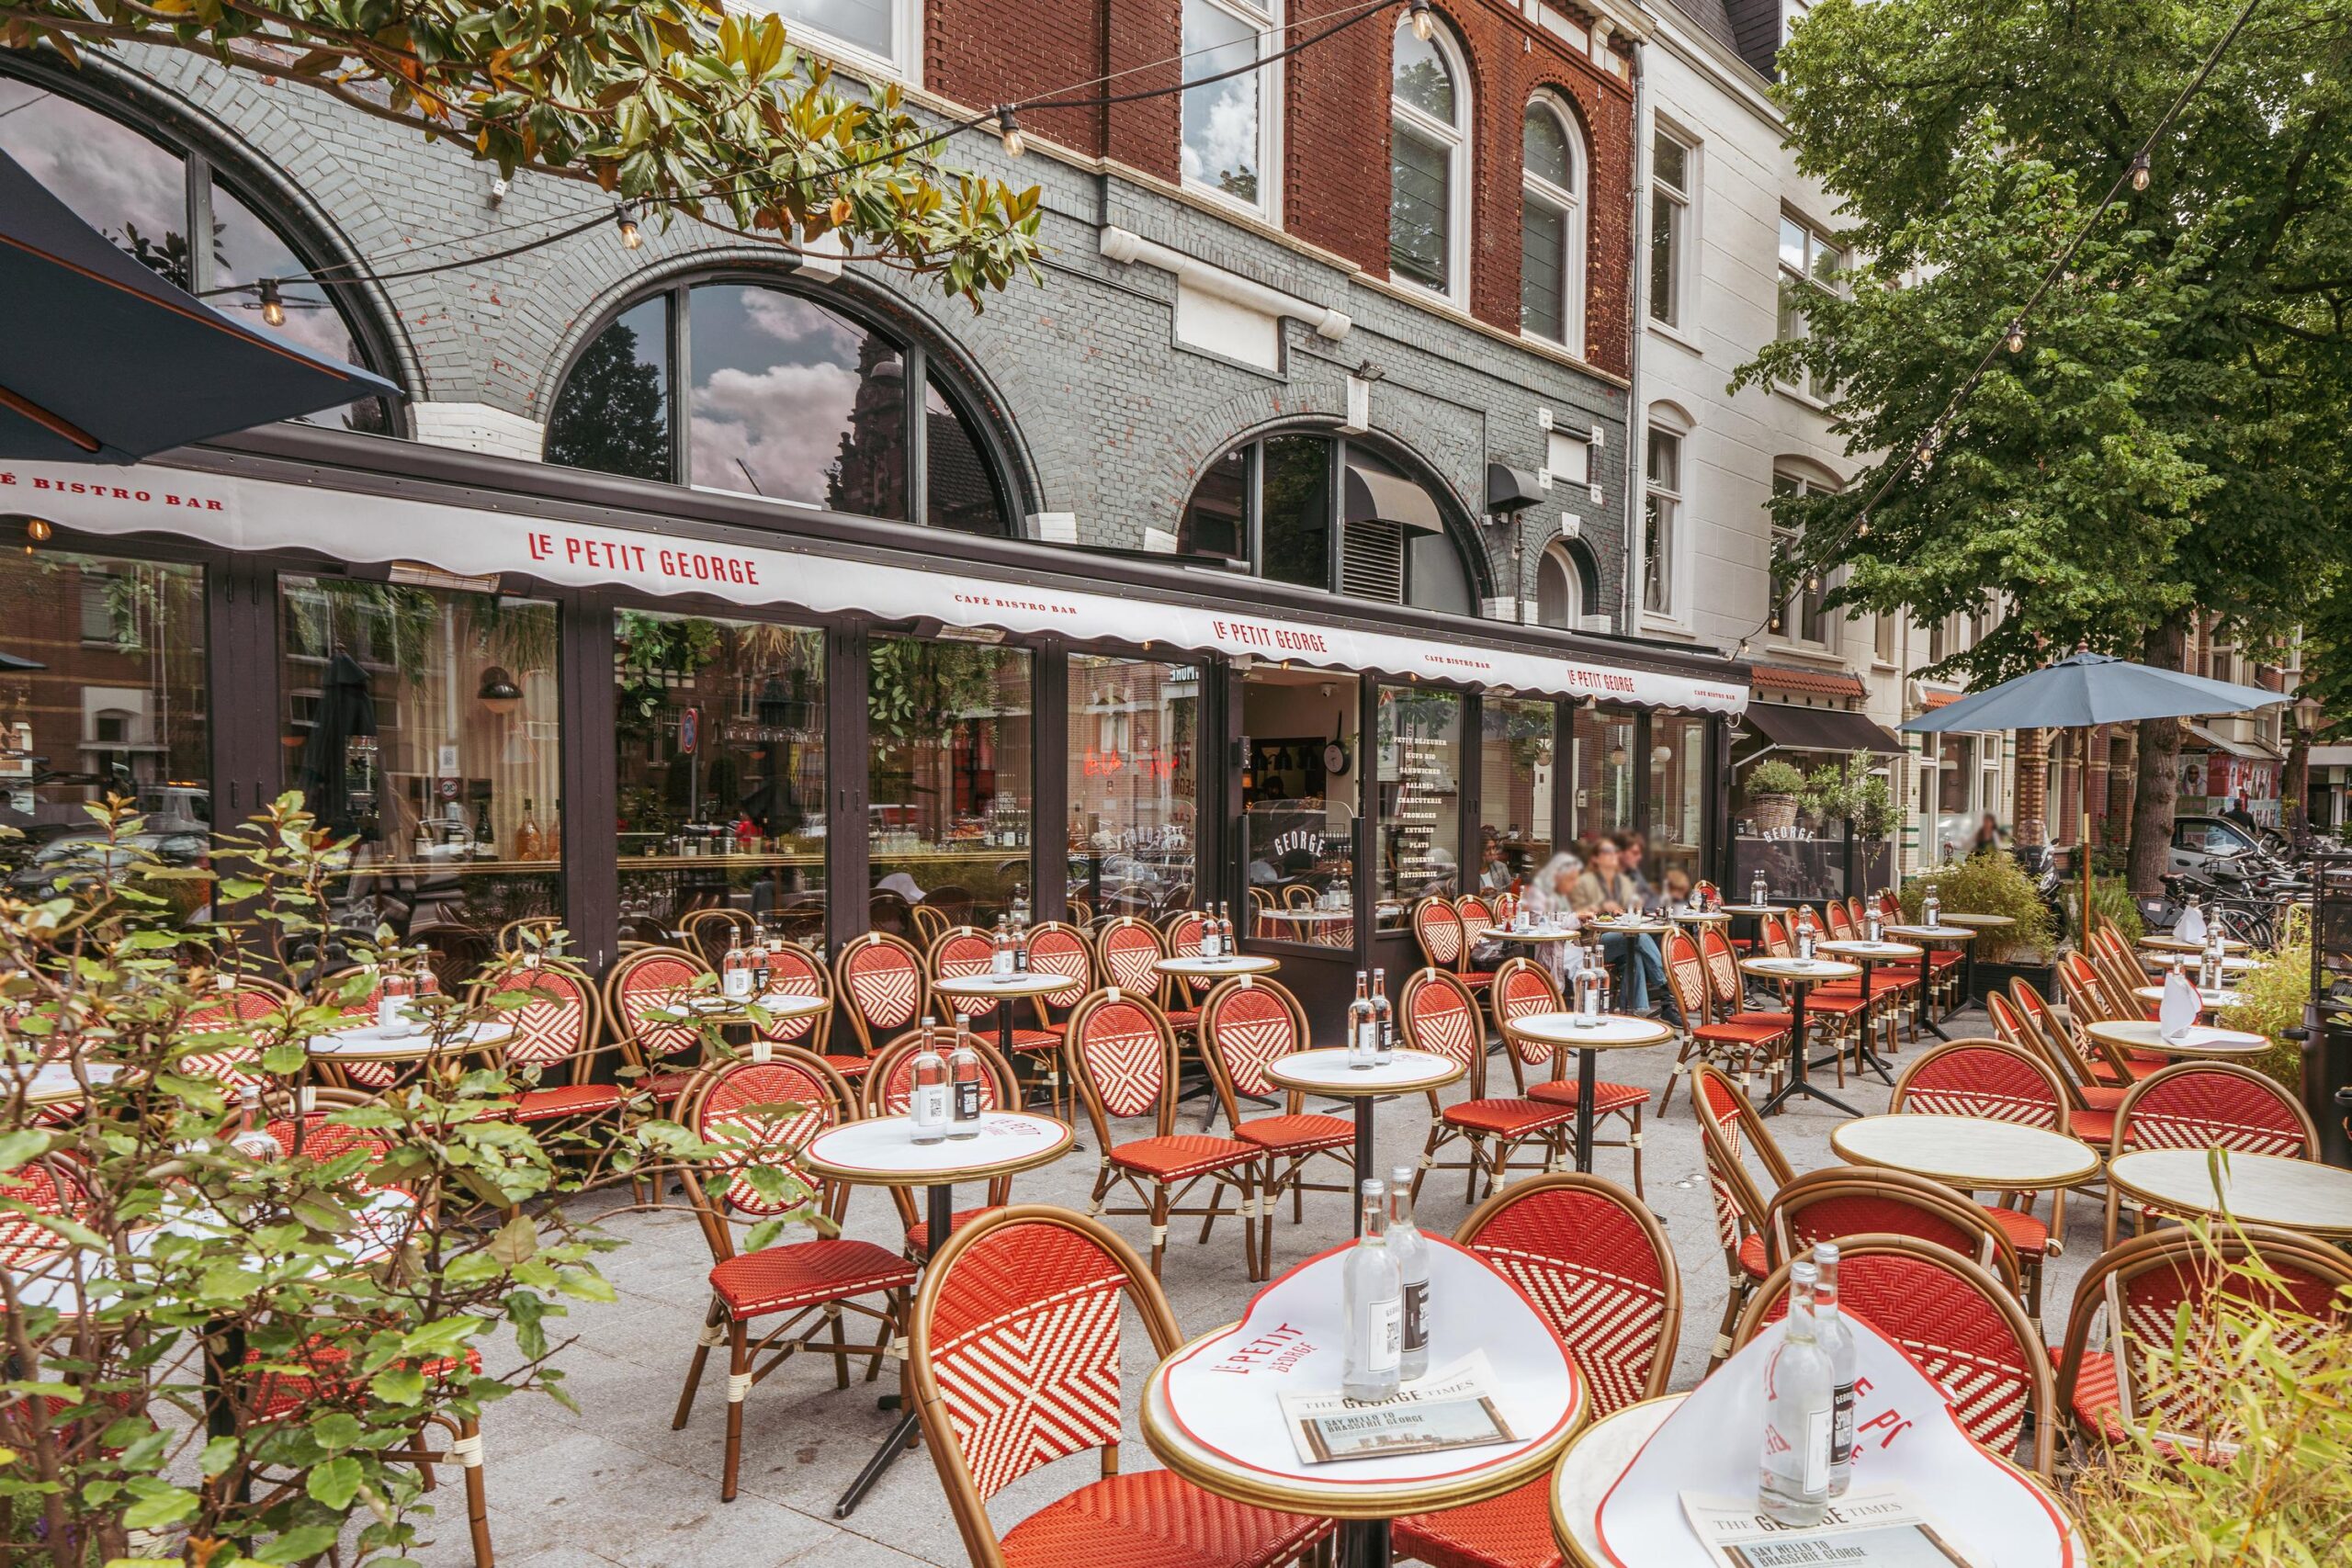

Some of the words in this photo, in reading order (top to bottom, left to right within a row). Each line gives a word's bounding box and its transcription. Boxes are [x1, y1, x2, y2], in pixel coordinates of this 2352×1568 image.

[33, 478, 151, 502] BISTRO
[165, 494, 223, 511] BAR
[528, 532, 553, 560] LE
[565, 537, 645, 572] PETIT
[660, 550, 759, 585] GEORGE
[955, 594, 989, 605] CAFÉ
[996, 599, 1046, 611] BISTRO
[1051, 605, 1078, 615] BAR
[1213, 621, 1227, 639] LE
[1230, 624, 1271, 647] PETIT
[1275, 630, 1328, 653] GEORGE
[1446, 658, 1473, 667] BISTRO
[1567, 669, 1576, 684] LE
[1577, 671, 1601, 689] PETIT
[1603, 674, 1634, 693] GEORGE
[1415, 738, 1447, 746] DÉJEUNER
[1274, 830, 1326, 857] GEORGE
[1763, 826, 1815, 843] GEORGE
[1399, 870, 1438, 878] PÂTISSERIE
[1227, 1323, 1304, 1363] PETIT
[1268, 1341, 1318, 1373] GEORGE
[1425, 1380, 1474, 1396] TIMES
[1325, 1419, 1345, 1427] SAY
[1348, 1415, 1378, 1425] HELLO
[1328, 1421, 1382, 1433] BRASSERIE
[1386, 1415, 1425, 1426] GEORGE
[1713, 1520, 1753, 1530] THE
[1846, 1503, 1903, 1517] TIMES
[1750, 1545, 1773, 1558] SAY
[1775, 1541, 1813, 1554] HELLO
[1815, 1540, 1830, 1551] TO
[1758, 1551, 1822, 1567] BRASSERIE
[1823, 1547, 1869, 1561] GEORGE
